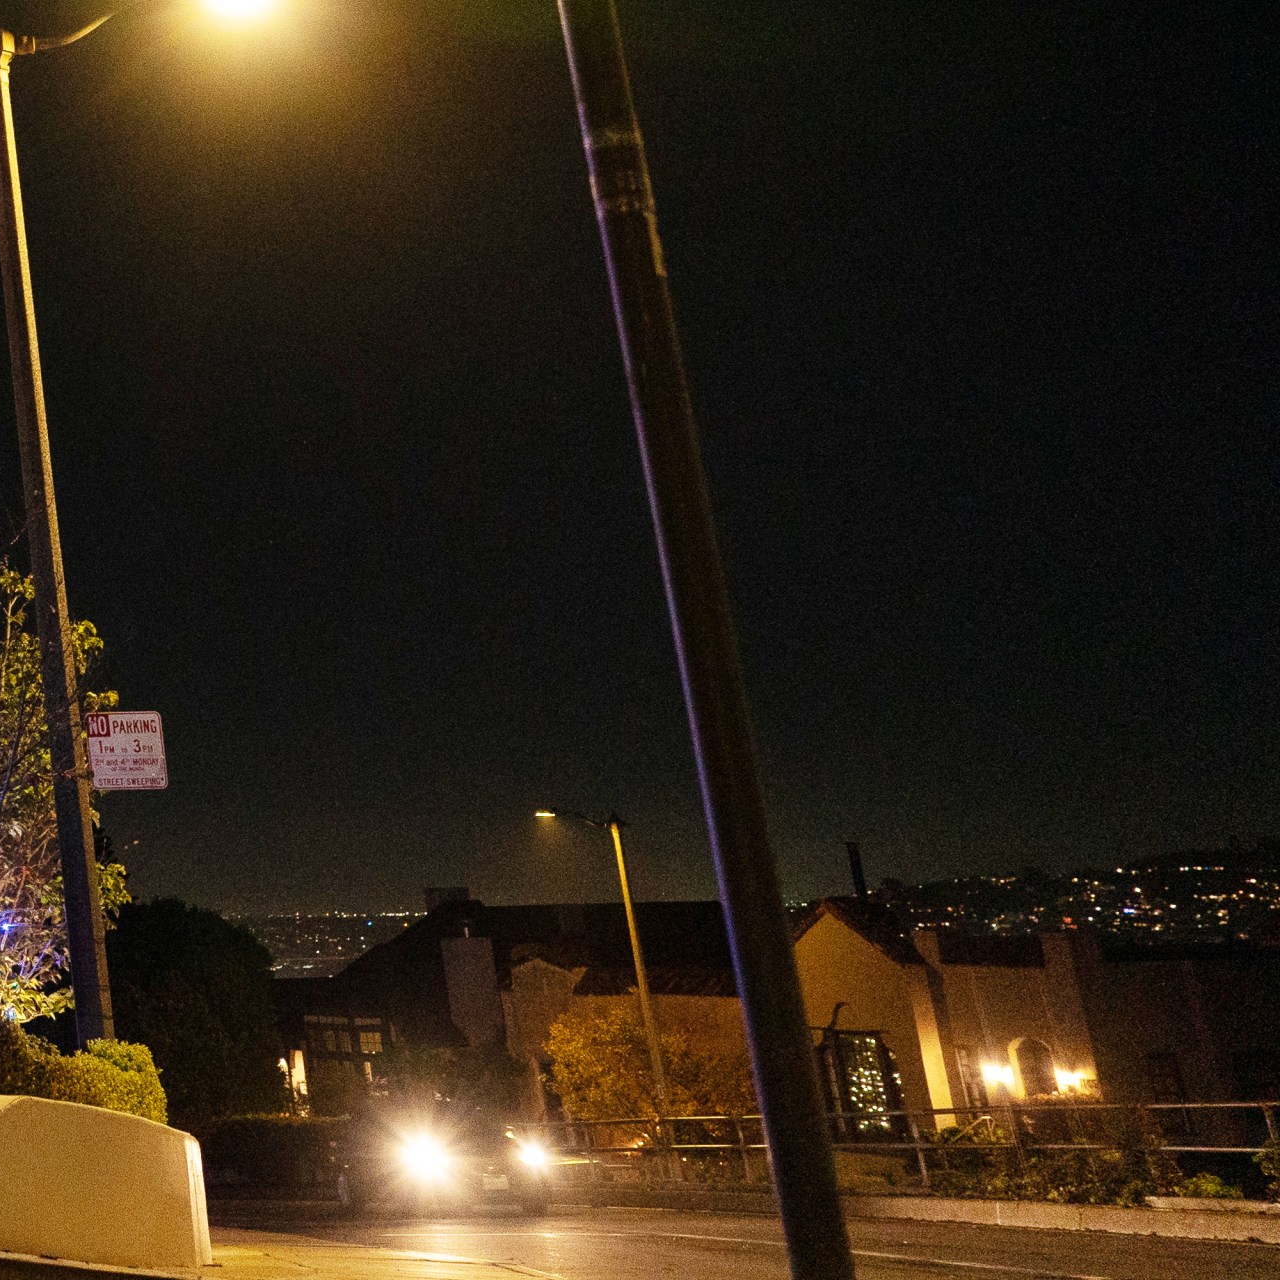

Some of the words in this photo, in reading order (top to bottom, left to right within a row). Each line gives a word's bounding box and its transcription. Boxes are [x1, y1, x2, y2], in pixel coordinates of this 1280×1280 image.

[88, 716, 107, 735] NO
[113, 720, 157, 734] PARKING
[132, 758, 159, 766] MONDAY
[98, 777, 124, 786] STREET
